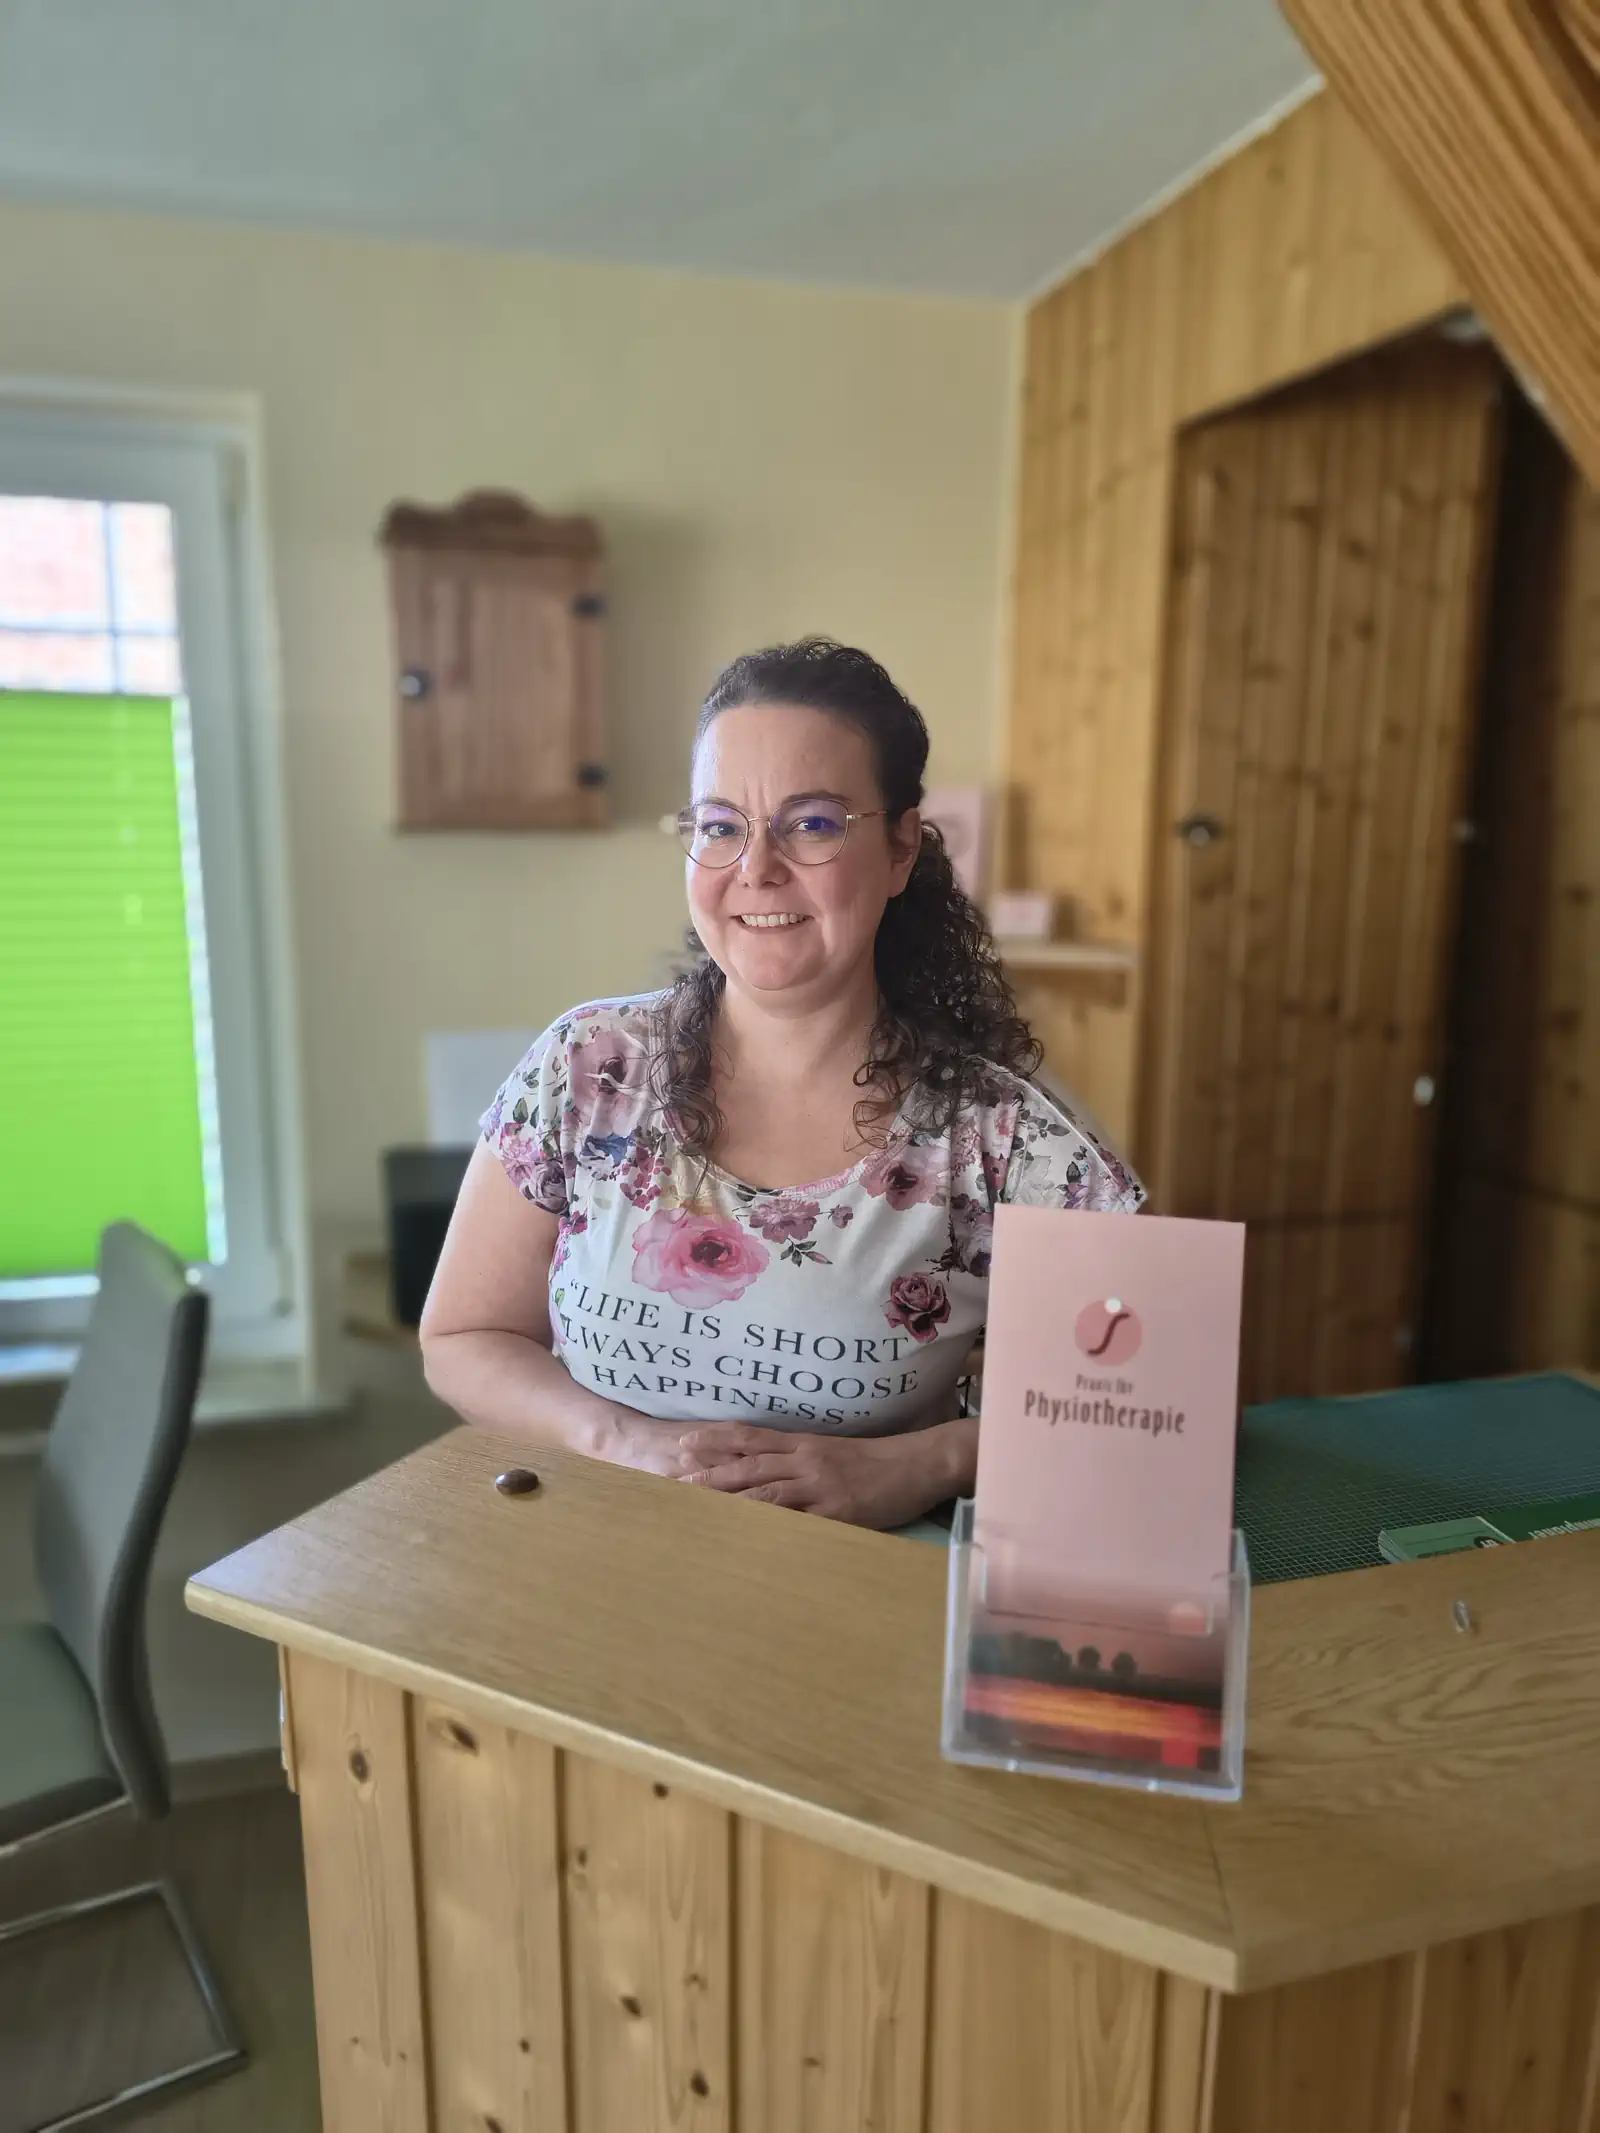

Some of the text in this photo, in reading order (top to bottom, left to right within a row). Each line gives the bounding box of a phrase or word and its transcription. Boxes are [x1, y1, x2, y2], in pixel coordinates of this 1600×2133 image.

[563, 1316, 919, 1399] LWAYS CHOOSE
[684, 1311, 721, 1339] IS
[744, 1323, 910, 1363] SHORT
[1024, 1390, 1186, 1438] Physiotherapie
